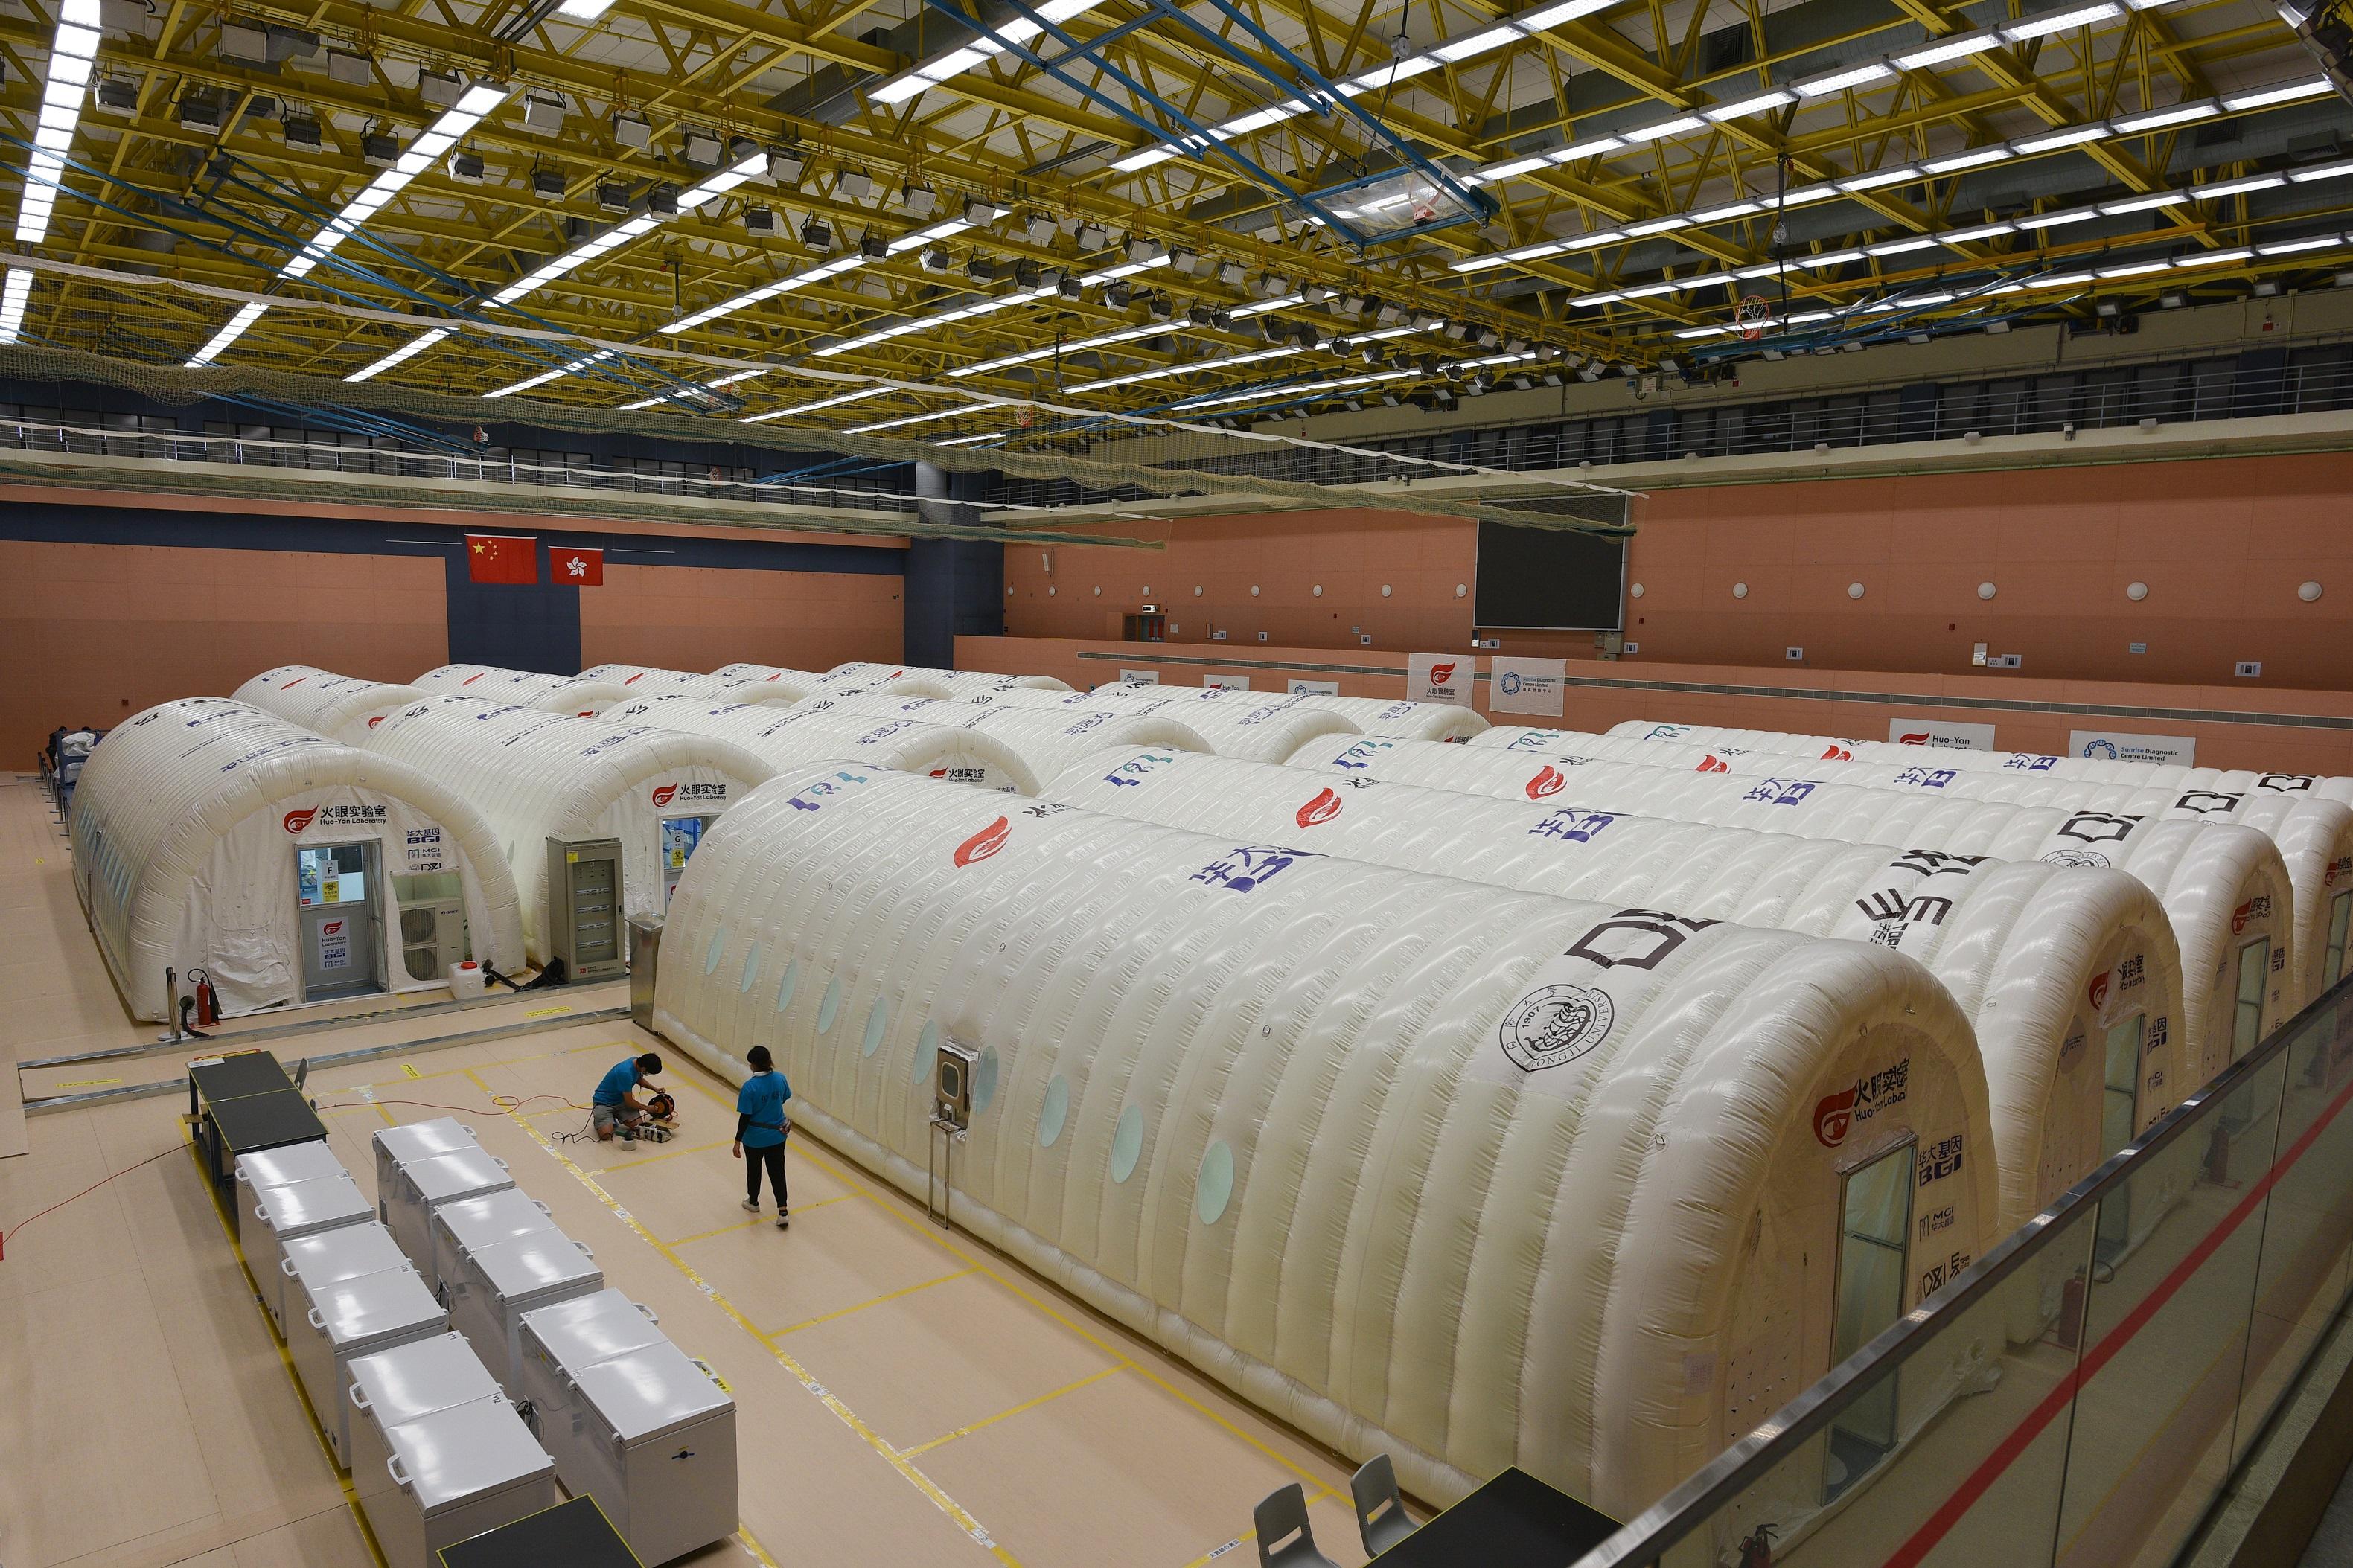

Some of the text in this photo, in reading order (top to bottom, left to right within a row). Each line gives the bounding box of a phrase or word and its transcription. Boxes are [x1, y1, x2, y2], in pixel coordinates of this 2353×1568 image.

[1426, 687, 1455, 696] 火眼實驗室
[1932, 735, 1970, 745] Huo-Yan
[320, 805, 387, 819] 火眼实验室
[351, 817, 387, 825] Laboratory
[406, 828, 440, 837] 华大基因
[407, 836, 441, 845] BGI
[328, 866, 333, 874] F
[1918, 1134, 1963, 1168] 华大基因
[1918, 1153, 1962, 1188] BGI
[1932, 1205, 1954, 1221] MGI
[447, 1332, 457, 1340] Y11
[491, 1395, 502, 1404] Y12
